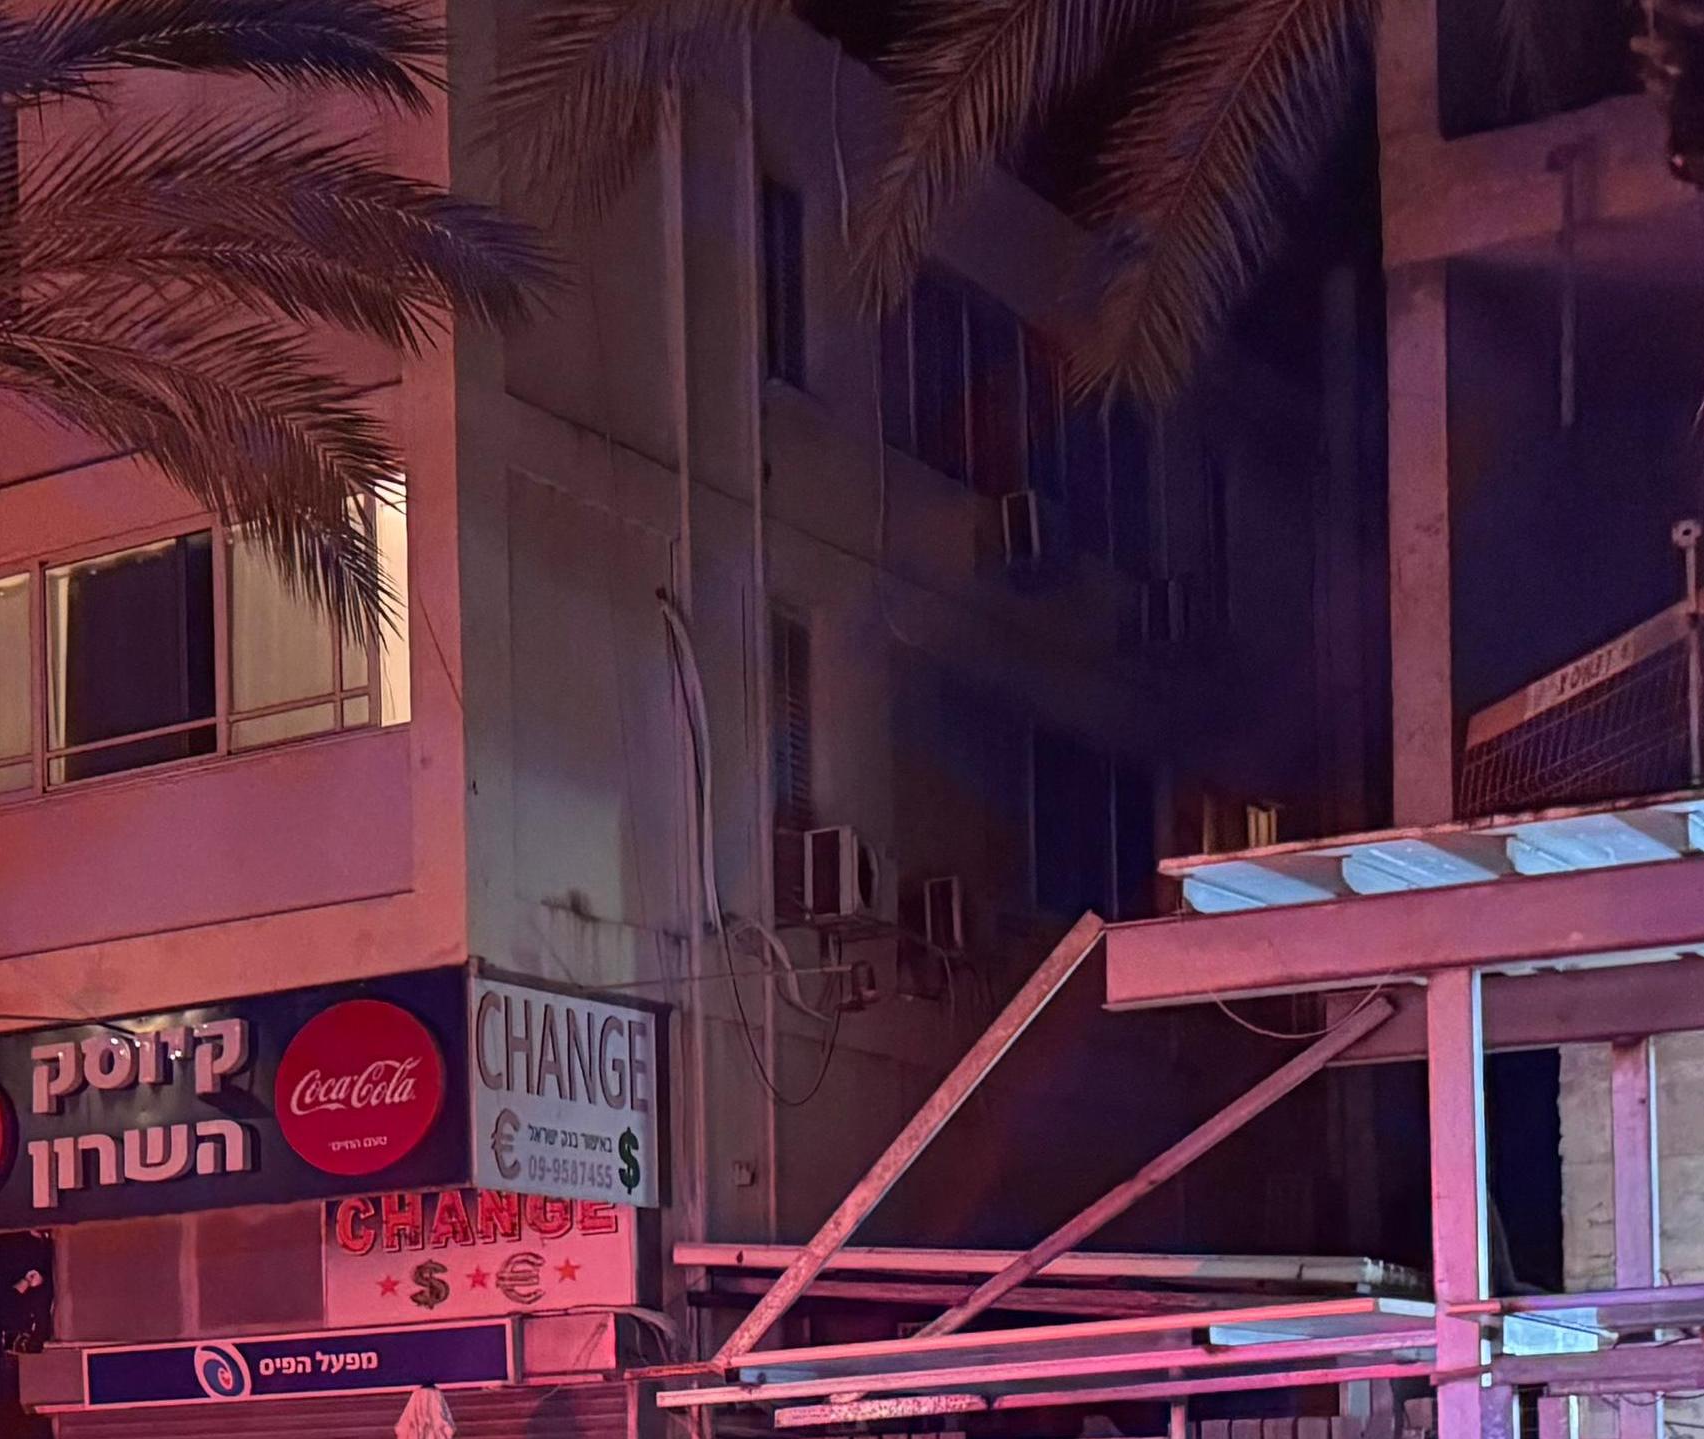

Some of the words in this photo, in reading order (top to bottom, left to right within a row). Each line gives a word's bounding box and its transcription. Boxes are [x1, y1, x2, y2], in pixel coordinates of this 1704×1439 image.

[31, 1017, 248, 1115] קיוסק
[476, 988, 648, 1112] CHANGE
[290, 1056, 423, 1115] Coca-Cola
[528, 1124, 558, 1143] ישראל
[560, 1130, 579, 1148] בנק
[581, 1133, 613, 1153] באישור
[28, 1120, 252, 1208] השרון
[336, 1189, 619, 1256] CHANGE
[259, 1355, 312, 1376] הפיס
[315, 1351, 378, 1374] מפעל
